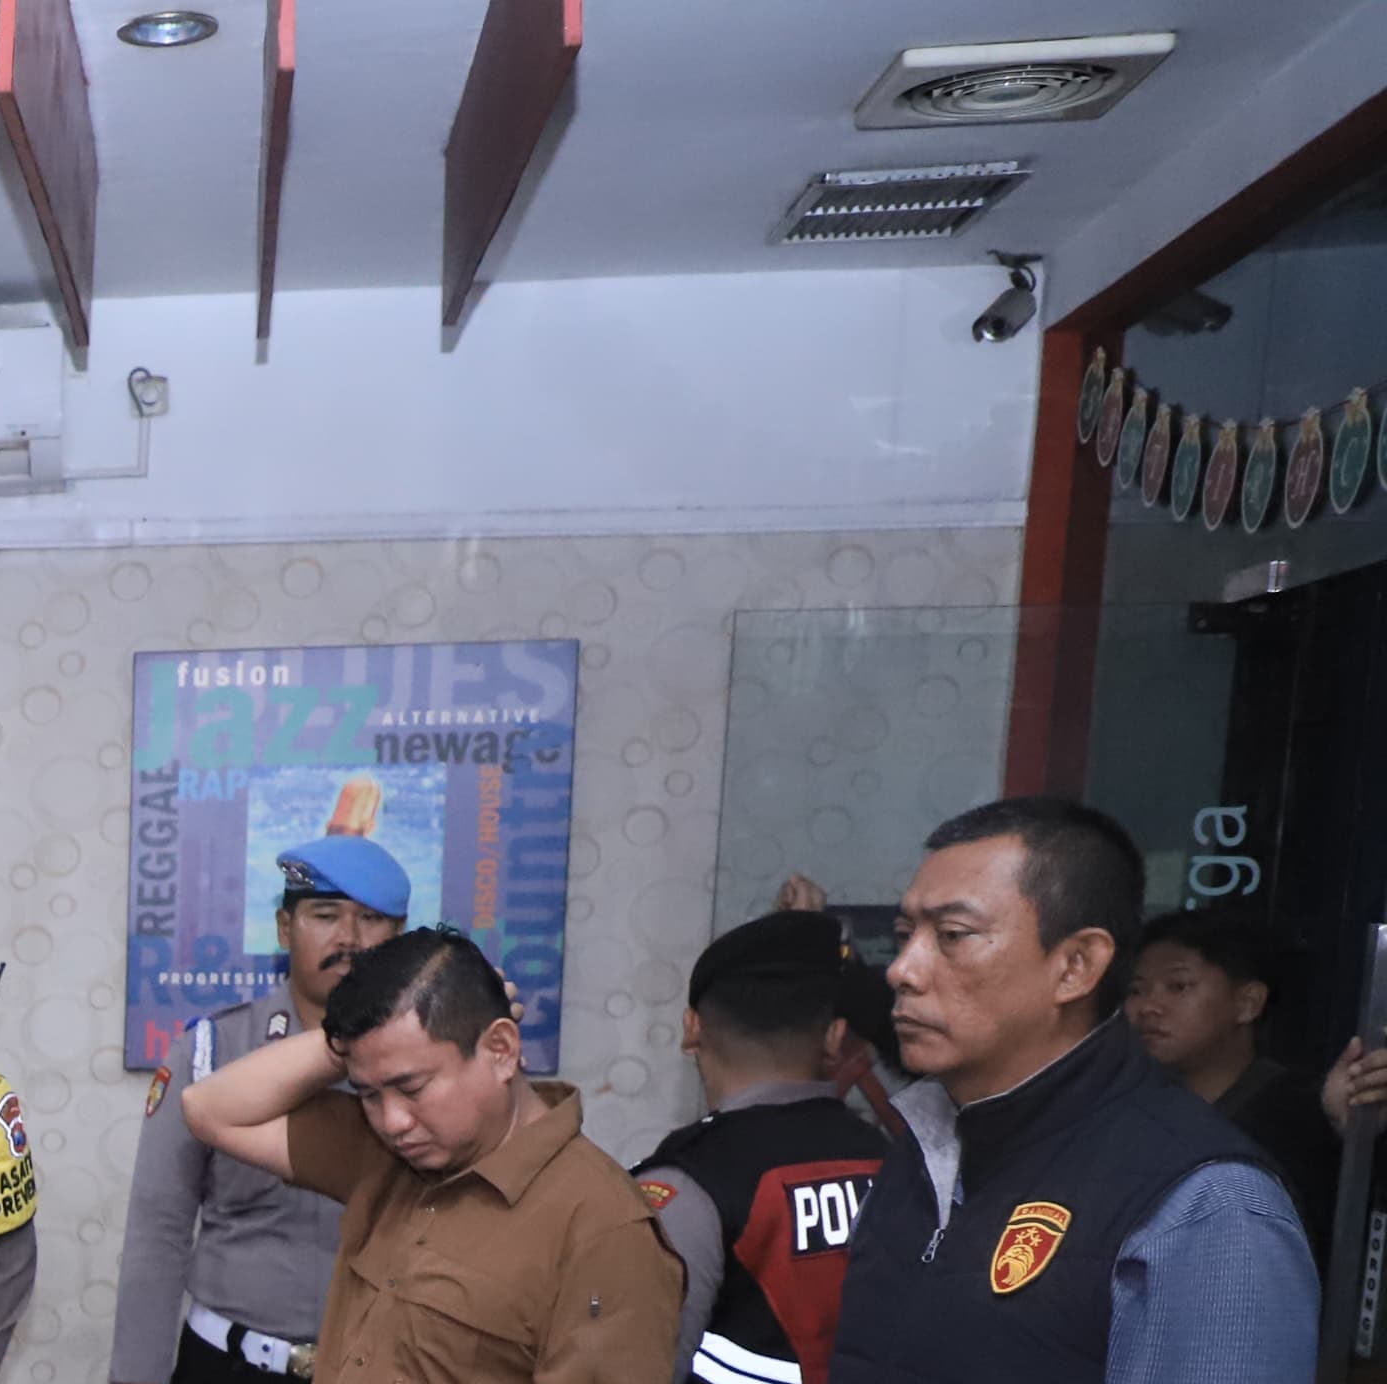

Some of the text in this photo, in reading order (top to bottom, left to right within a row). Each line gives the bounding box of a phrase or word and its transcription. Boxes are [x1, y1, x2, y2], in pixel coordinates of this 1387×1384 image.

[177, 660, 290, 688] fusion
[134, 660, 379, 771] Jazz
[382, 710, 540, 726] ALTERNATIVE
[178, 770, 248, 800] RAP
[135, 758, 180, 938] REGGAE
[472, 764, 503, 930] DISCO/HOUSE
